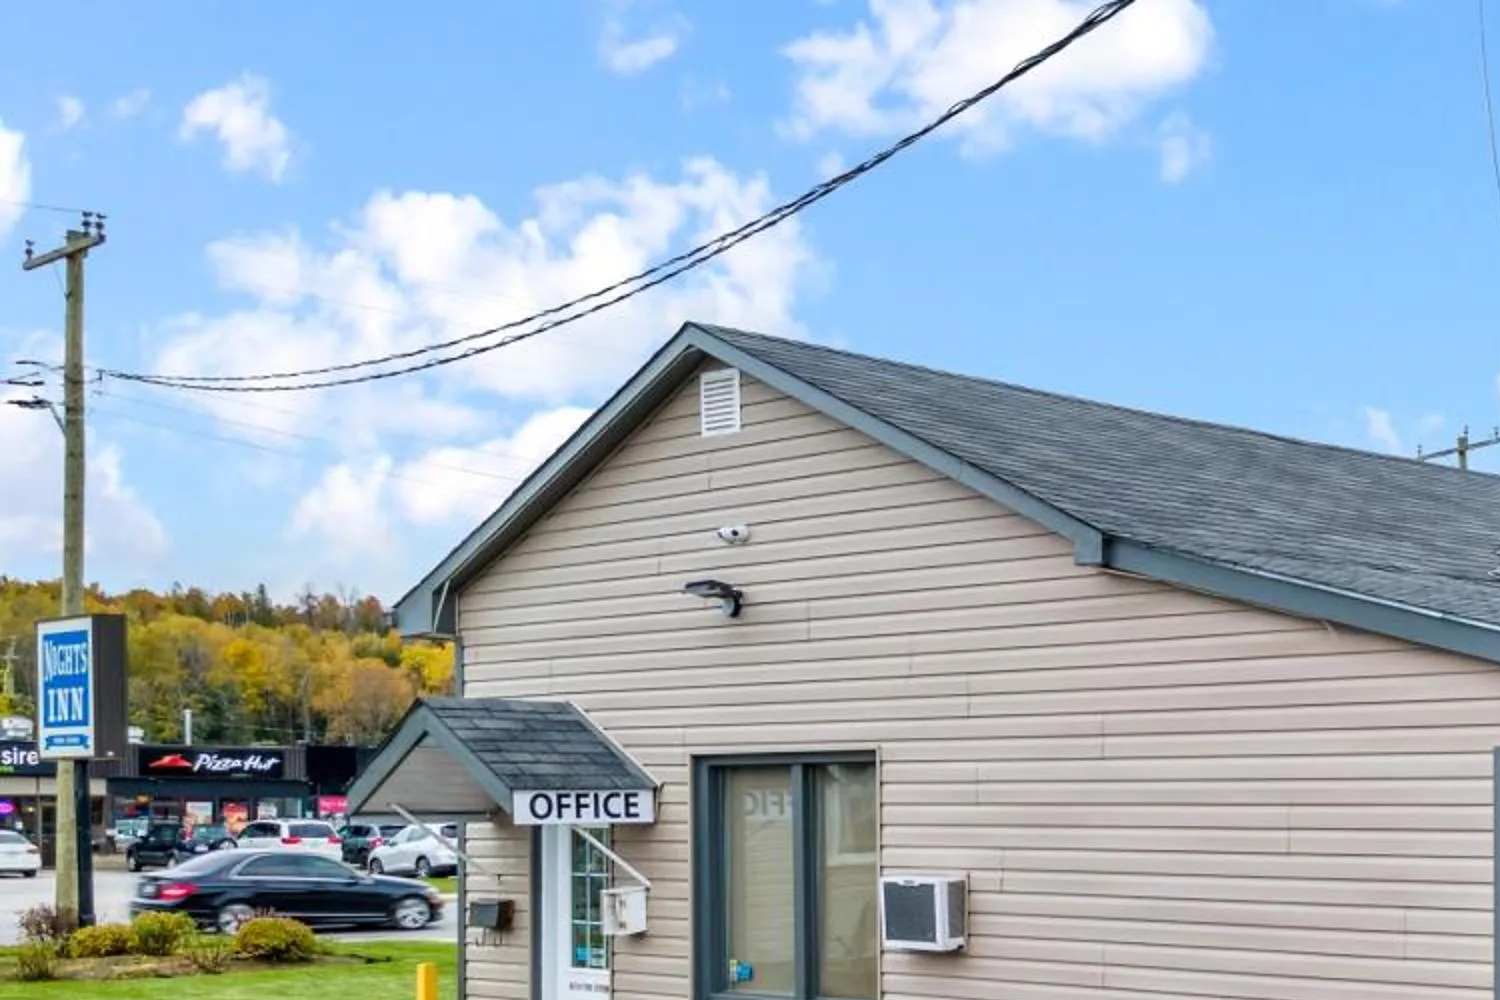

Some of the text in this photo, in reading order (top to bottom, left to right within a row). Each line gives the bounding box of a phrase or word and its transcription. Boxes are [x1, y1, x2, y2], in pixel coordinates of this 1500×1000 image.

[48, 687, 84, 722] INN
[1, 747, 39, 765] sire
[192, 753, 280, 773] Pizza Hut
[529, 791, 640, 819] OFFICE
